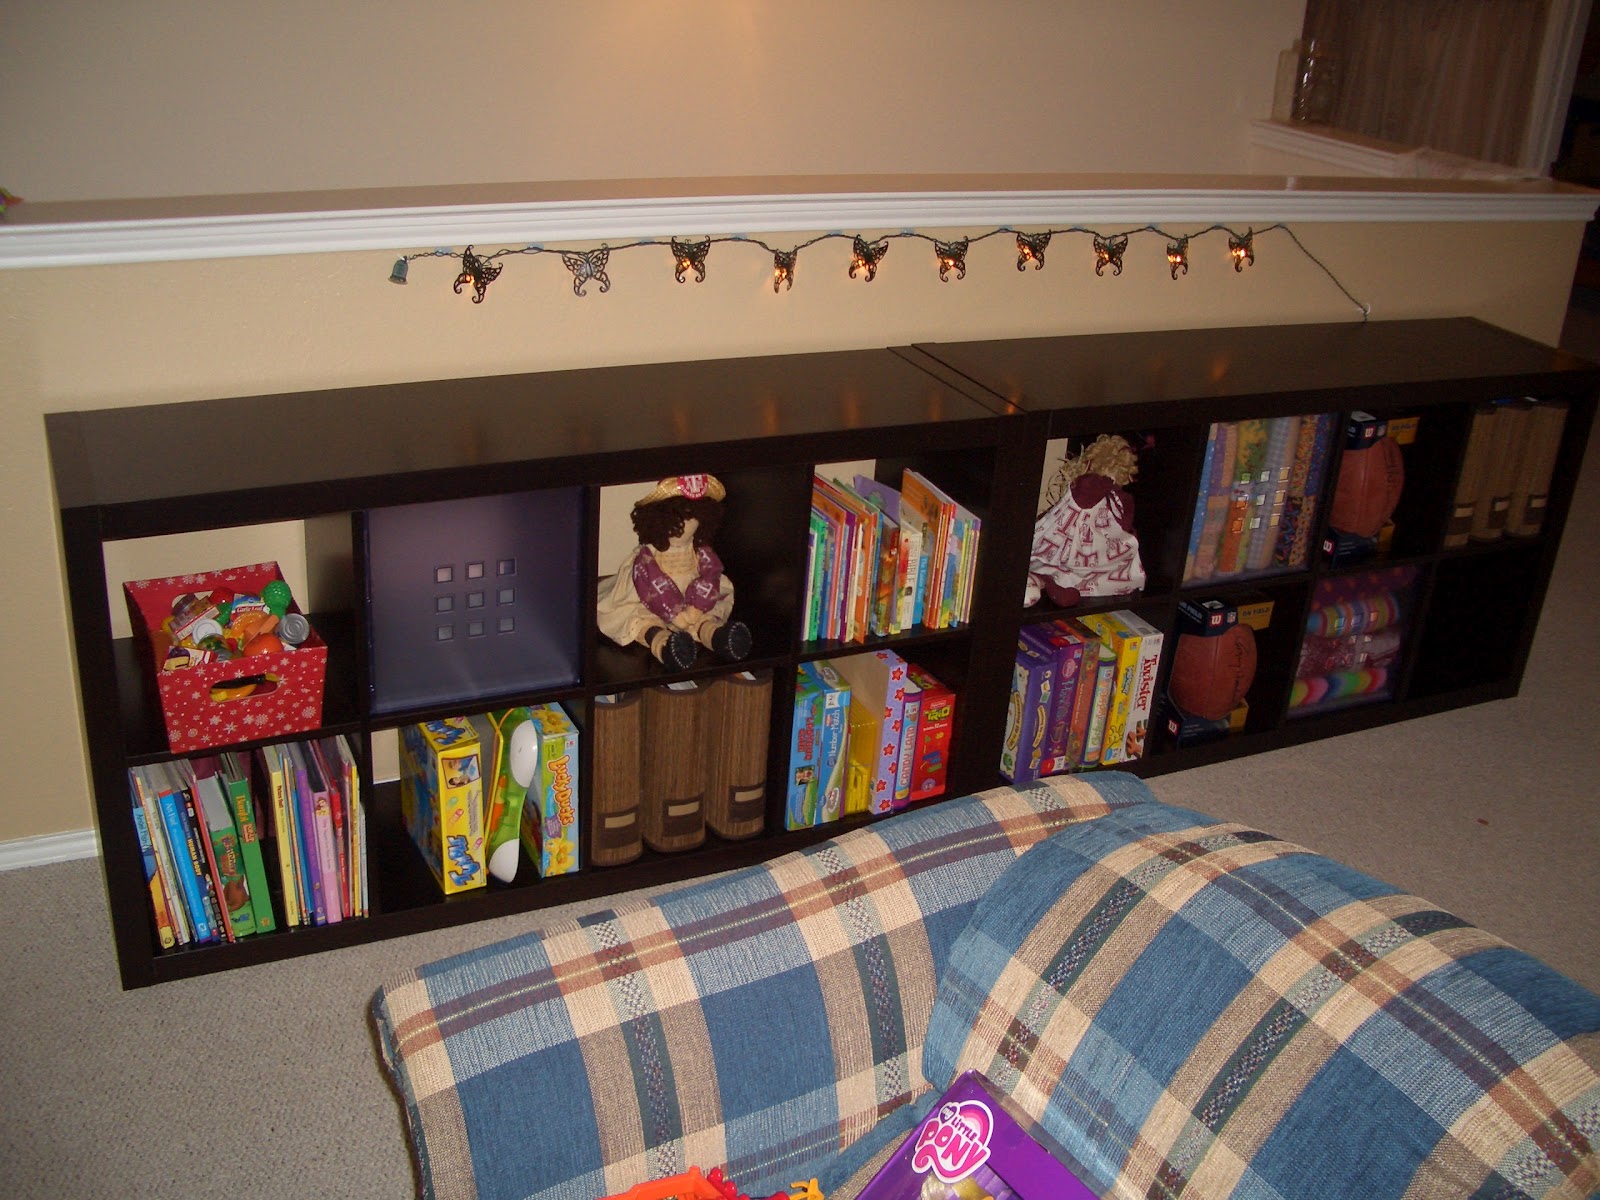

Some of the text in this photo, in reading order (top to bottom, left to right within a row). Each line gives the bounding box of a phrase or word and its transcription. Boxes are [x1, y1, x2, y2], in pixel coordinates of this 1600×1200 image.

[1135, 653, 1158, 711] Twister
[829, 708, 841, 727] Match
[827, 726, 838, 758] Number
[899, 725, 917, 787] CANDY LAND
[547, 754, 569, 796] Lucky
[235, 796, 248, 823] Bambi
[554, 788, 576, 827] Ducks
[187, 838, 198, 861] HUMAN
[193, 860, 202, 876] BODY
[447, 834, 482, 888] TUMBLE
[915, 1120, 987, 1178] PONY
